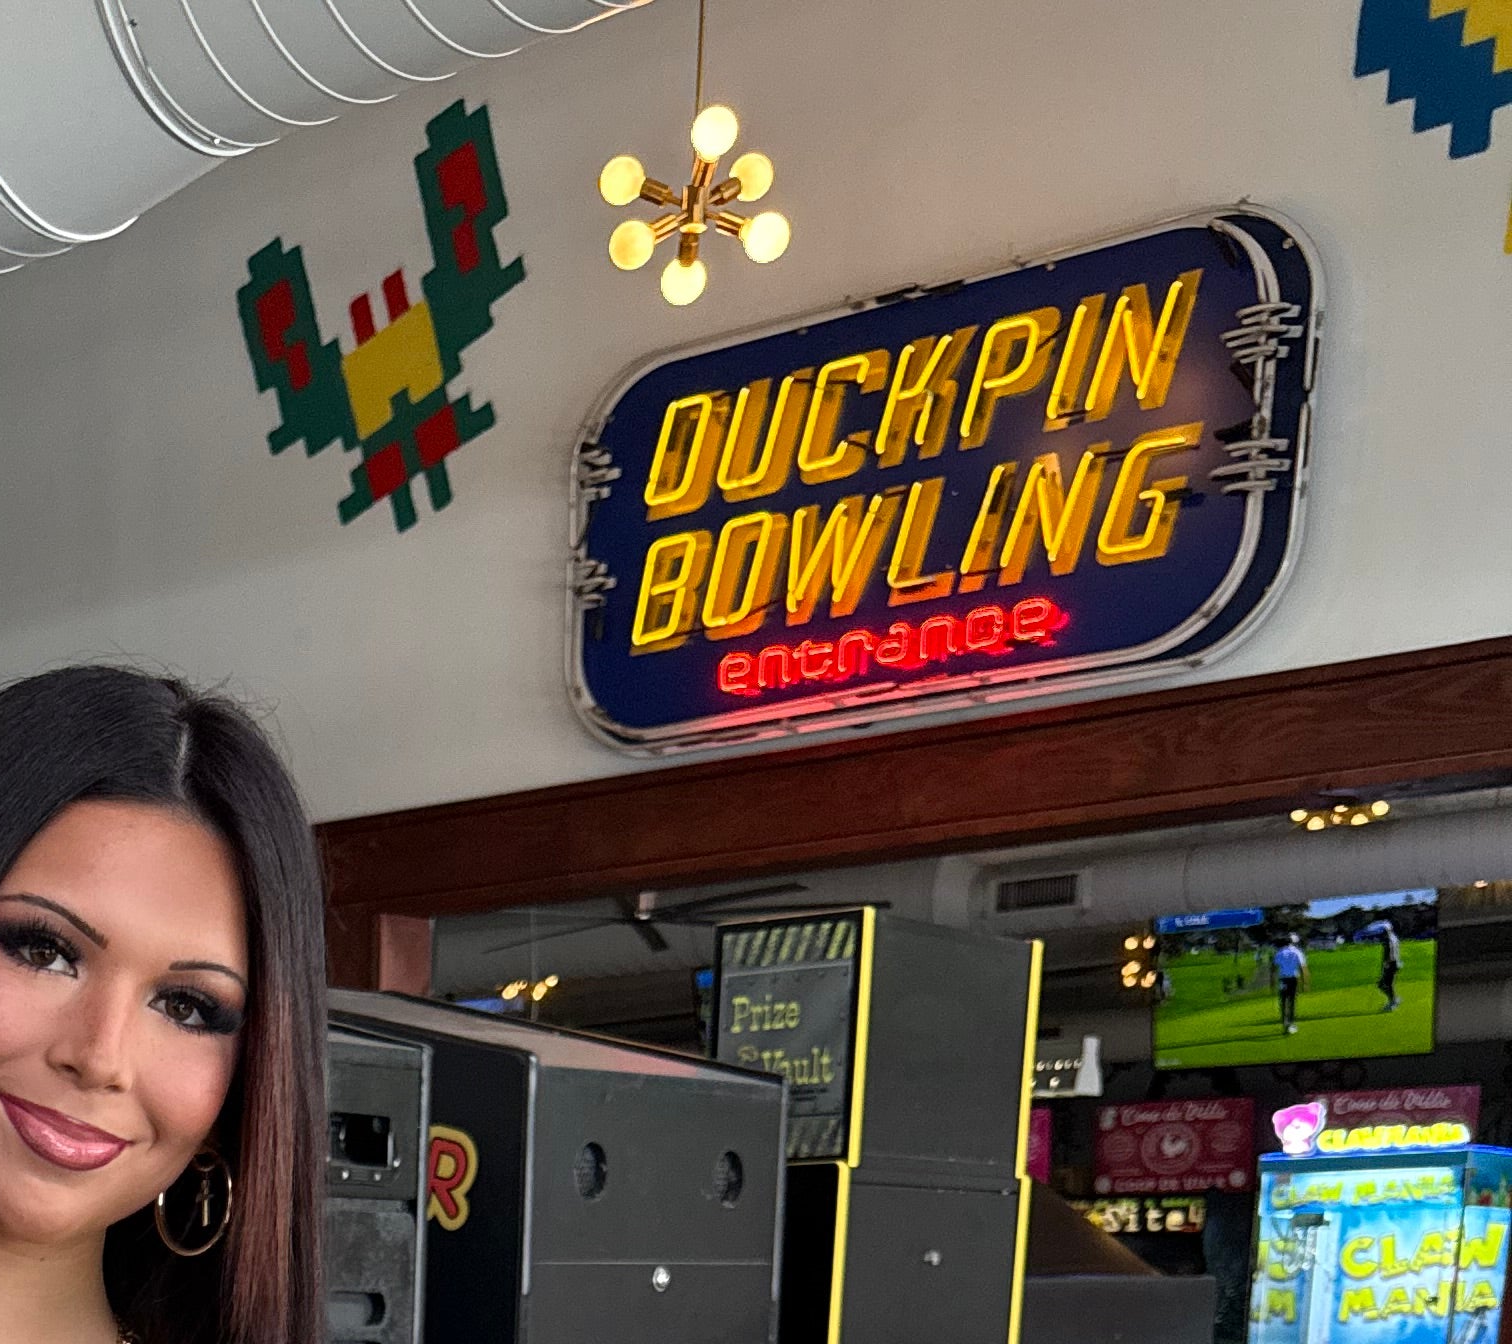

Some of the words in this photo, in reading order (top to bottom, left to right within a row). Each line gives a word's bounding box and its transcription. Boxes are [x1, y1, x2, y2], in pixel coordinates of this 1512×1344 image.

[645, 269, 1204, 521] DUCKPIN
[631, 421, 1203, 655] BOWLING
[718, 598, 1060, 696] entrance
[731, 994, 801, 1034] Prize
[761, 1046, 835, 1085] Vault
[1340, 1222, 1507, 1280] CLAW
[1338, 1280, 1499, 1323] MANIA
